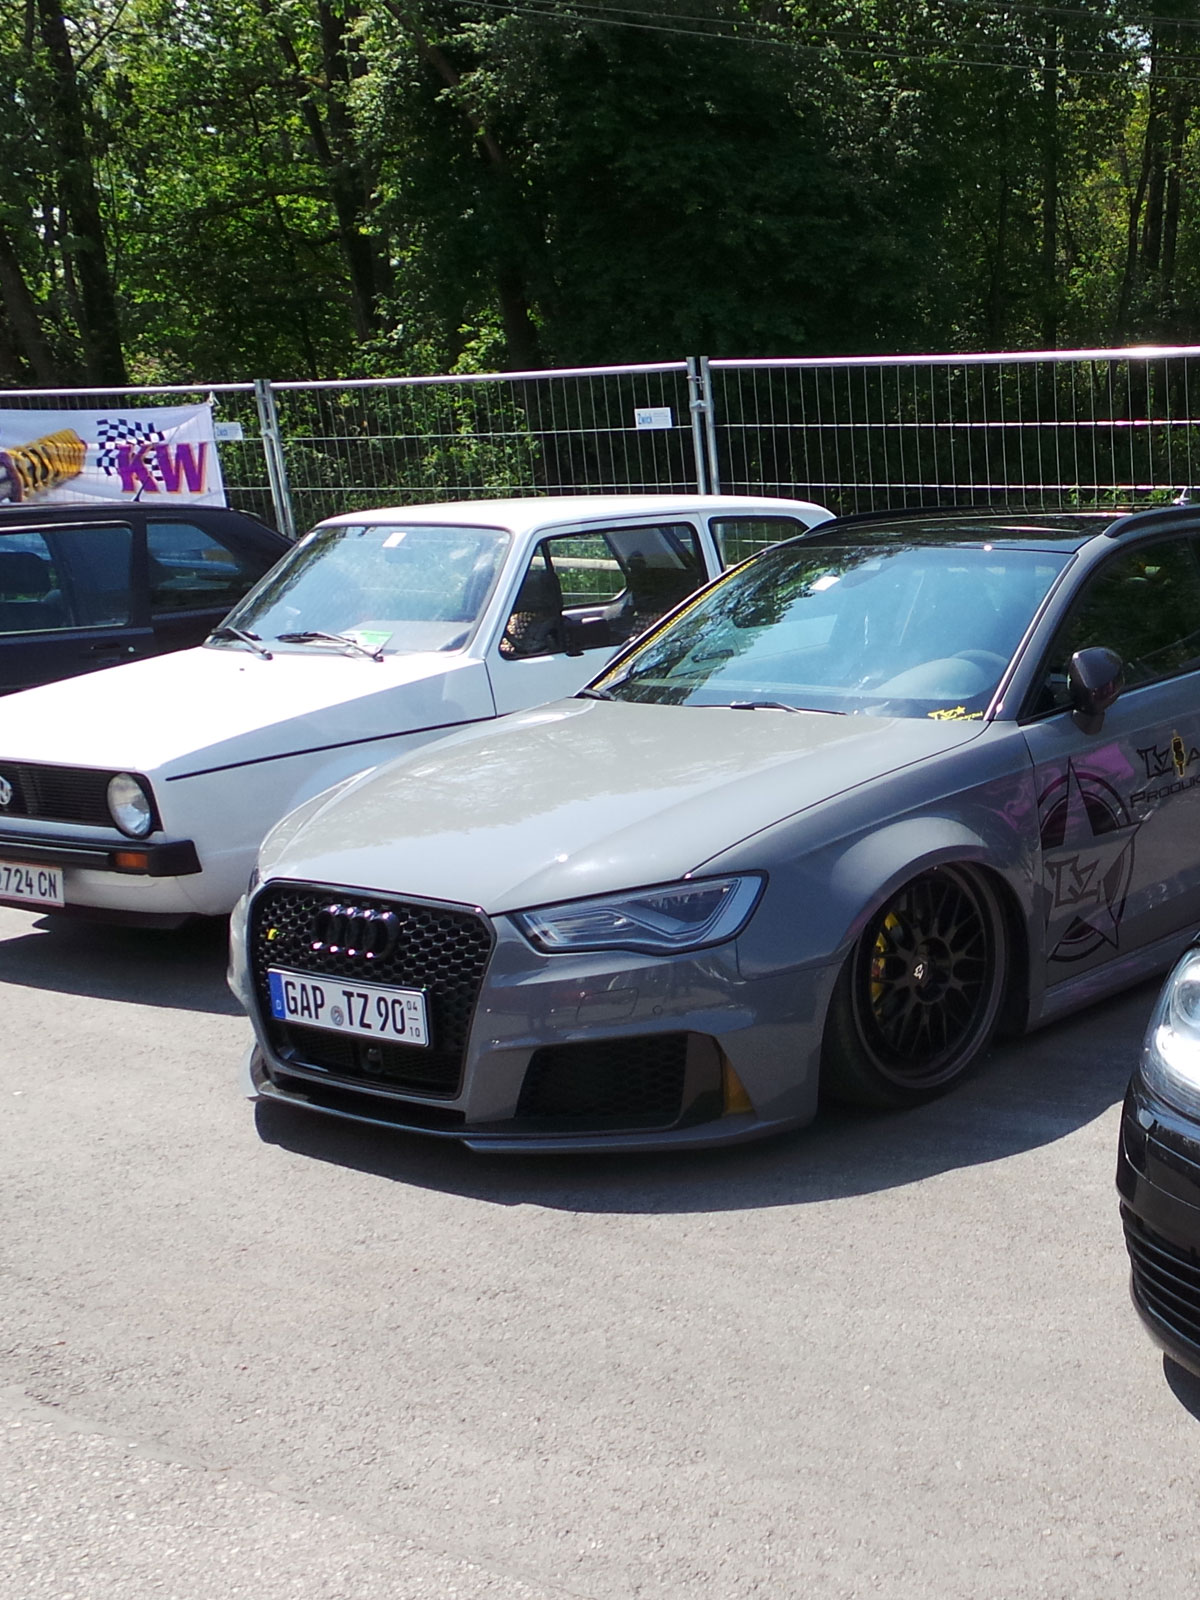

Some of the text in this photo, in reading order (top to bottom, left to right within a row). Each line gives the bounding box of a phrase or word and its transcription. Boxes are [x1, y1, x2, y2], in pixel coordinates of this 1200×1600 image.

[115, 442, 208, 494] KW
[3, 866, 57, 899] 724 CN
[284, 980, 406, 1035] GAP TZ 90
[406, 1000, 418, 1012] 04
